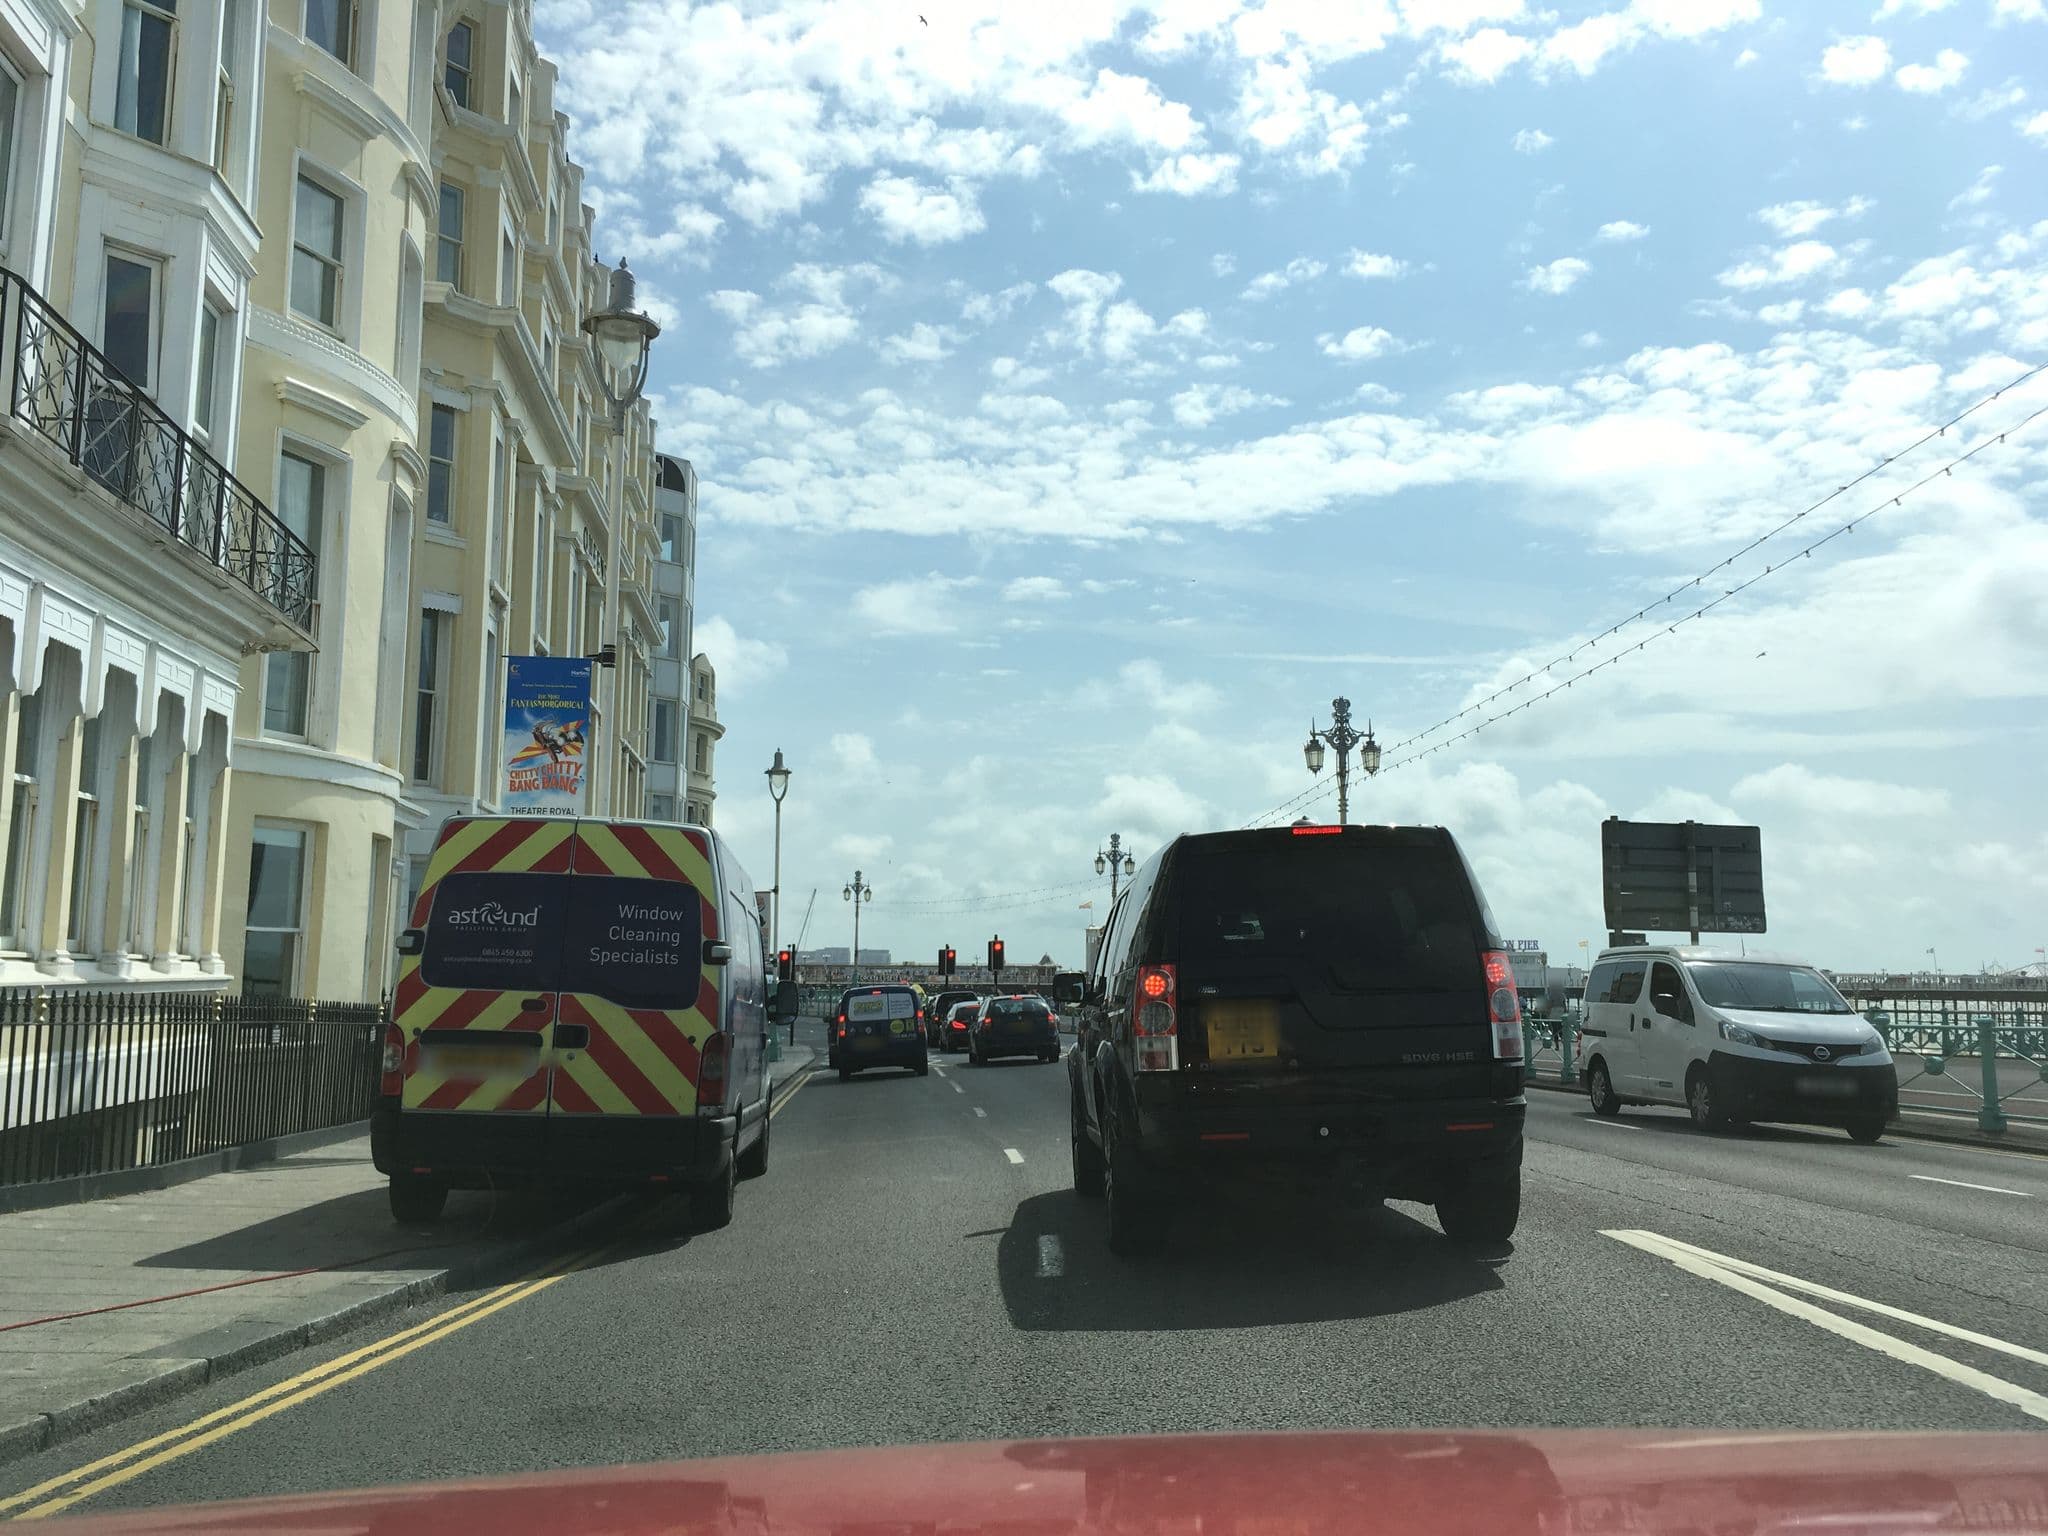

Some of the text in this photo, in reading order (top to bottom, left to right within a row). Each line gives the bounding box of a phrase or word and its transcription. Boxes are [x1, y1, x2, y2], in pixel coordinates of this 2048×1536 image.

[510, 761, 583, 780] CHITTY CHITTY
[509, 776, 580, 795] BANG BANG
[511, 806, 576, 816] THEATRE ROYAL
[618, 904, 683, 921] Window
[608, 926, 681, 947] Cleaning
[1518, 940, 1539, 950] PIER
[590, 947, 679, 965] Specialists
[1446, 1051, 1475, 1062] HSE
